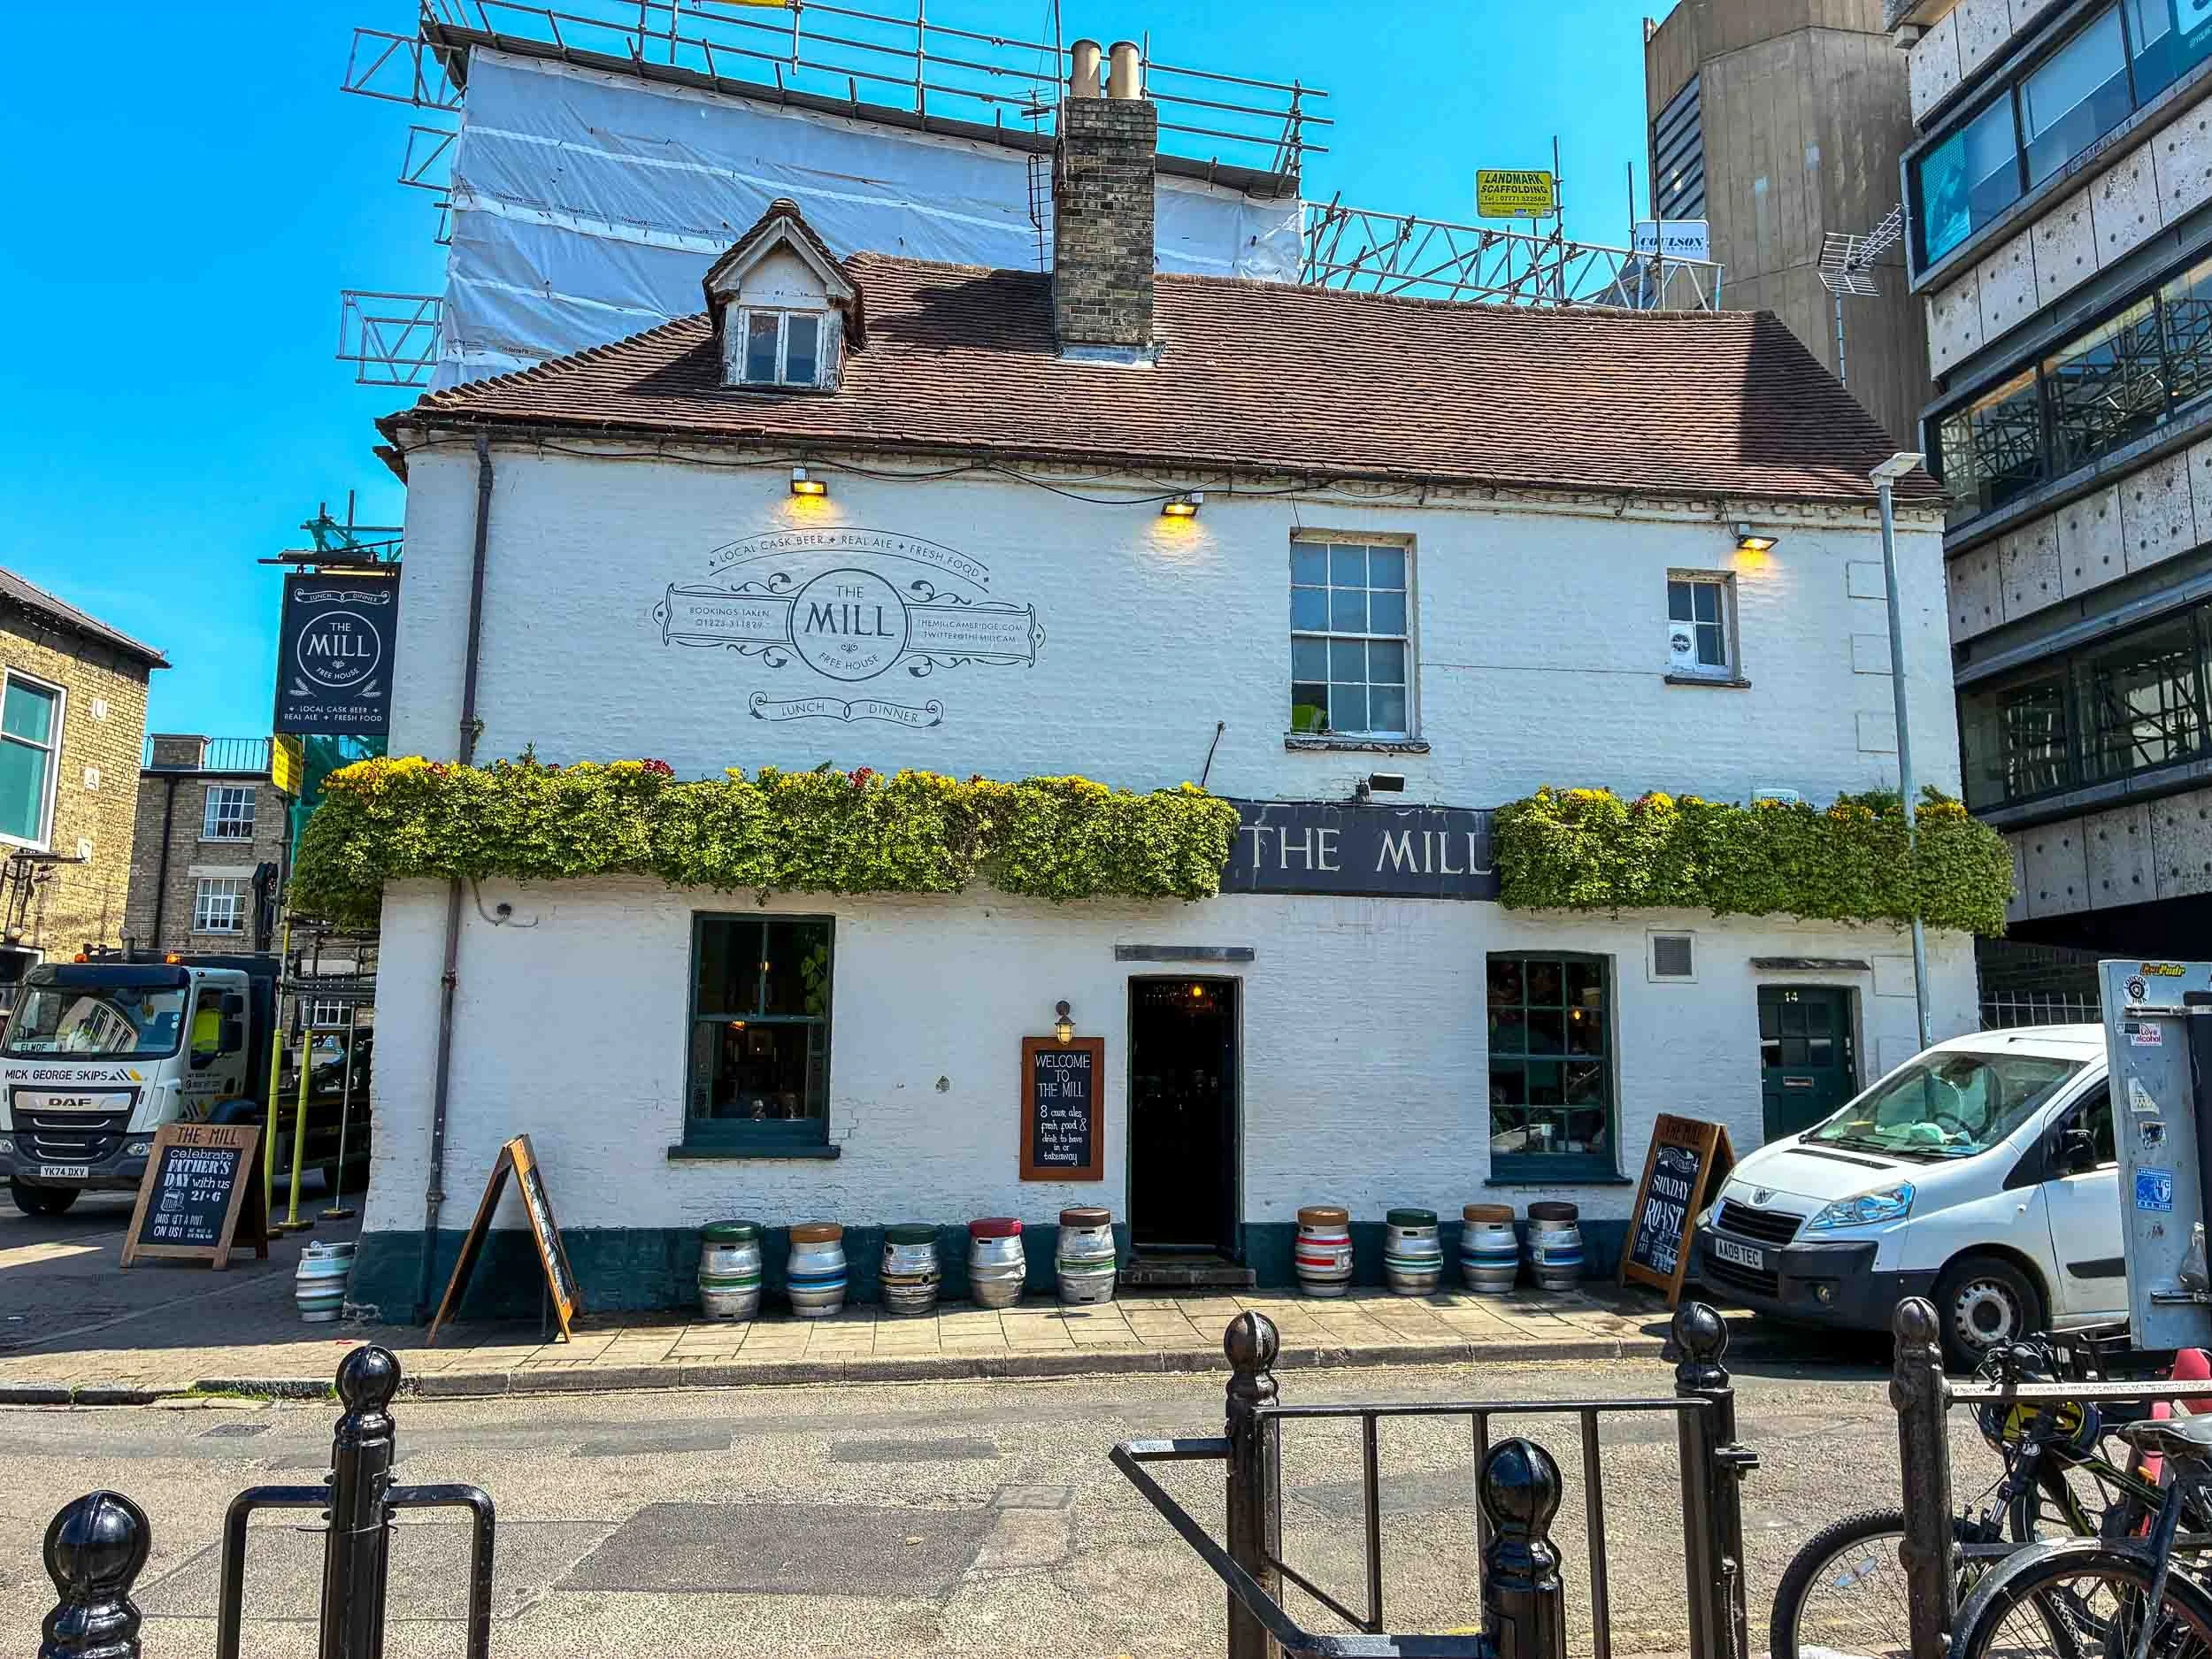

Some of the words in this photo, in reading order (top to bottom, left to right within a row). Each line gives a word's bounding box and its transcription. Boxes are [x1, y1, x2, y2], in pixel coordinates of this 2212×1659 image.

[1485, 173, 1544, 185] LANDMARK
[1480, 185, 1549, 194] SCAFFOLDING
[718, 543, 756, 564] LOCAL
[761, 536, 793, 550] CASK
[797, 534, 825, 546] BEER
[841, 534, 867, 547] REAL
[872, 537, 893, 549] ALE
[909, 544, 944, 567] FRESH
[946, 556, 979, 579] FOOD
[352, 593, 378, 603] DINNER
[834, 585, 864, 599] THE
[689, 607, 738, 617] BOOKINGS
[742, 608, 771, 617] TAKEN
[804, 602, 895, 637] MILL
[330, 622, 351, 632] THE
[307, 634, 372, 657] MILL
[819, 652, 841, 670] FREE
[844, 653, 879, 671] HOUSE
[317, 667, 333, 679] FREE
[334, 667, 360, 680] HOUSE
[780, 701, 826, 718] LUNCH
[868, 703, 919, 723] DINNER
[1239, 826, 1340, 872] THE
[1375, 830, 1493, 875] MILL
[1785, 991, 1798, 1002] 14
[1035, 1054, 1090, 1069] WELCOME
[5, 1070, 28, 1079] MICK
[33, 1071, 73, 1080] GEORGE
[76, 1071, 107, 1080] SKIPS
[1055, 1070, 1070, 1083] TO
[1037, 1082, 1058, 1097] THE
[1063, 1081, 1084, 1097] MILL
[48, 1098, 92, 1107] DAF
[1040, 1105, 1048, 1118] 8
[1068, 1105, 1082, 1118] ales
[1041, 1119, 1058, 1133] fresh
[1061, 1119, 1078, 1133] food
[1079, 1118, 1087, 1132] &
[177, 1126, 202, 1143] THE
[207, 1128, 237, 1145] MILL
[1060, 1133, 1067, 1143] to
[44, 1167, 65, 1176] YK74
[68, 1167, 85, 1176] DXV
[167, 1159, 230, 1175] FATHER'S
[163, 1173, 191, 1187] DAY
[192, 1177, 216, 1188] with
[218, 1180, 231, 1189] us
[1653, 1174, 1689, 1202] SUNDAY
[1644, 1197, 1685, 1233] ROAST
[153, 1225, 166, 1237] ON
[1741, 1248, 1759, 1265] TEC
